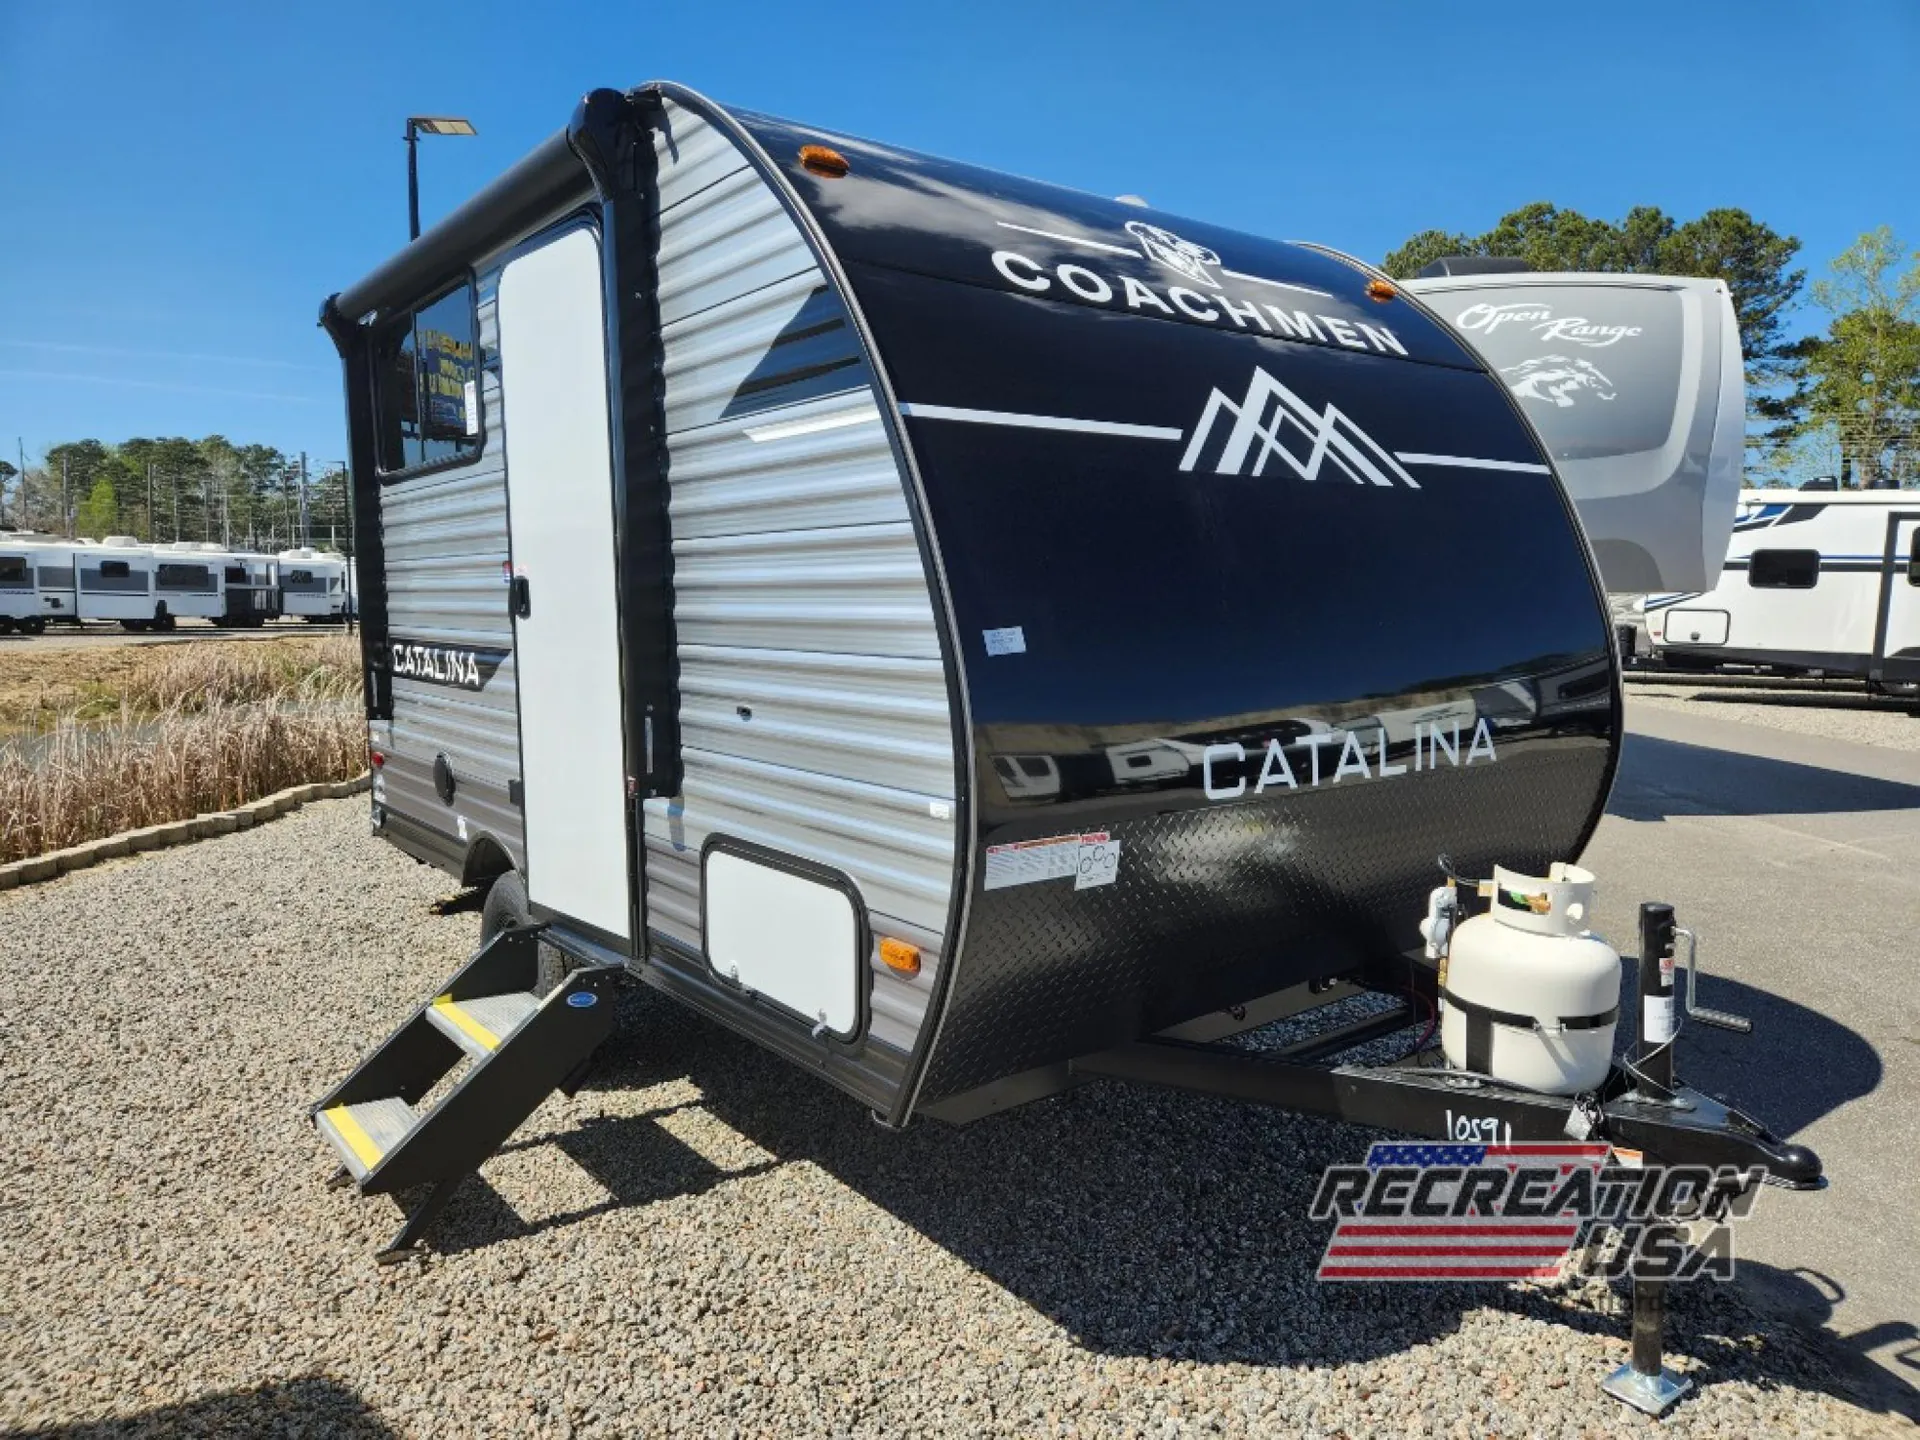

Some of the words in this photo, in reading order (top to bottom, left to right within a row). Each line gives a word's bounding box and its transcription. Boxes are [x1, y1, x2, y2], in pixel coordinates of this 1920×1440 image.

[991, 249, 1409, 356] COACHMEN
[1456, 303, 1553, 335] Open
[1530, 316, 1643, 348] Range
[393, 644, 479, 686] CATALINA
[1203, 717, 1498, 800] CATALINA
